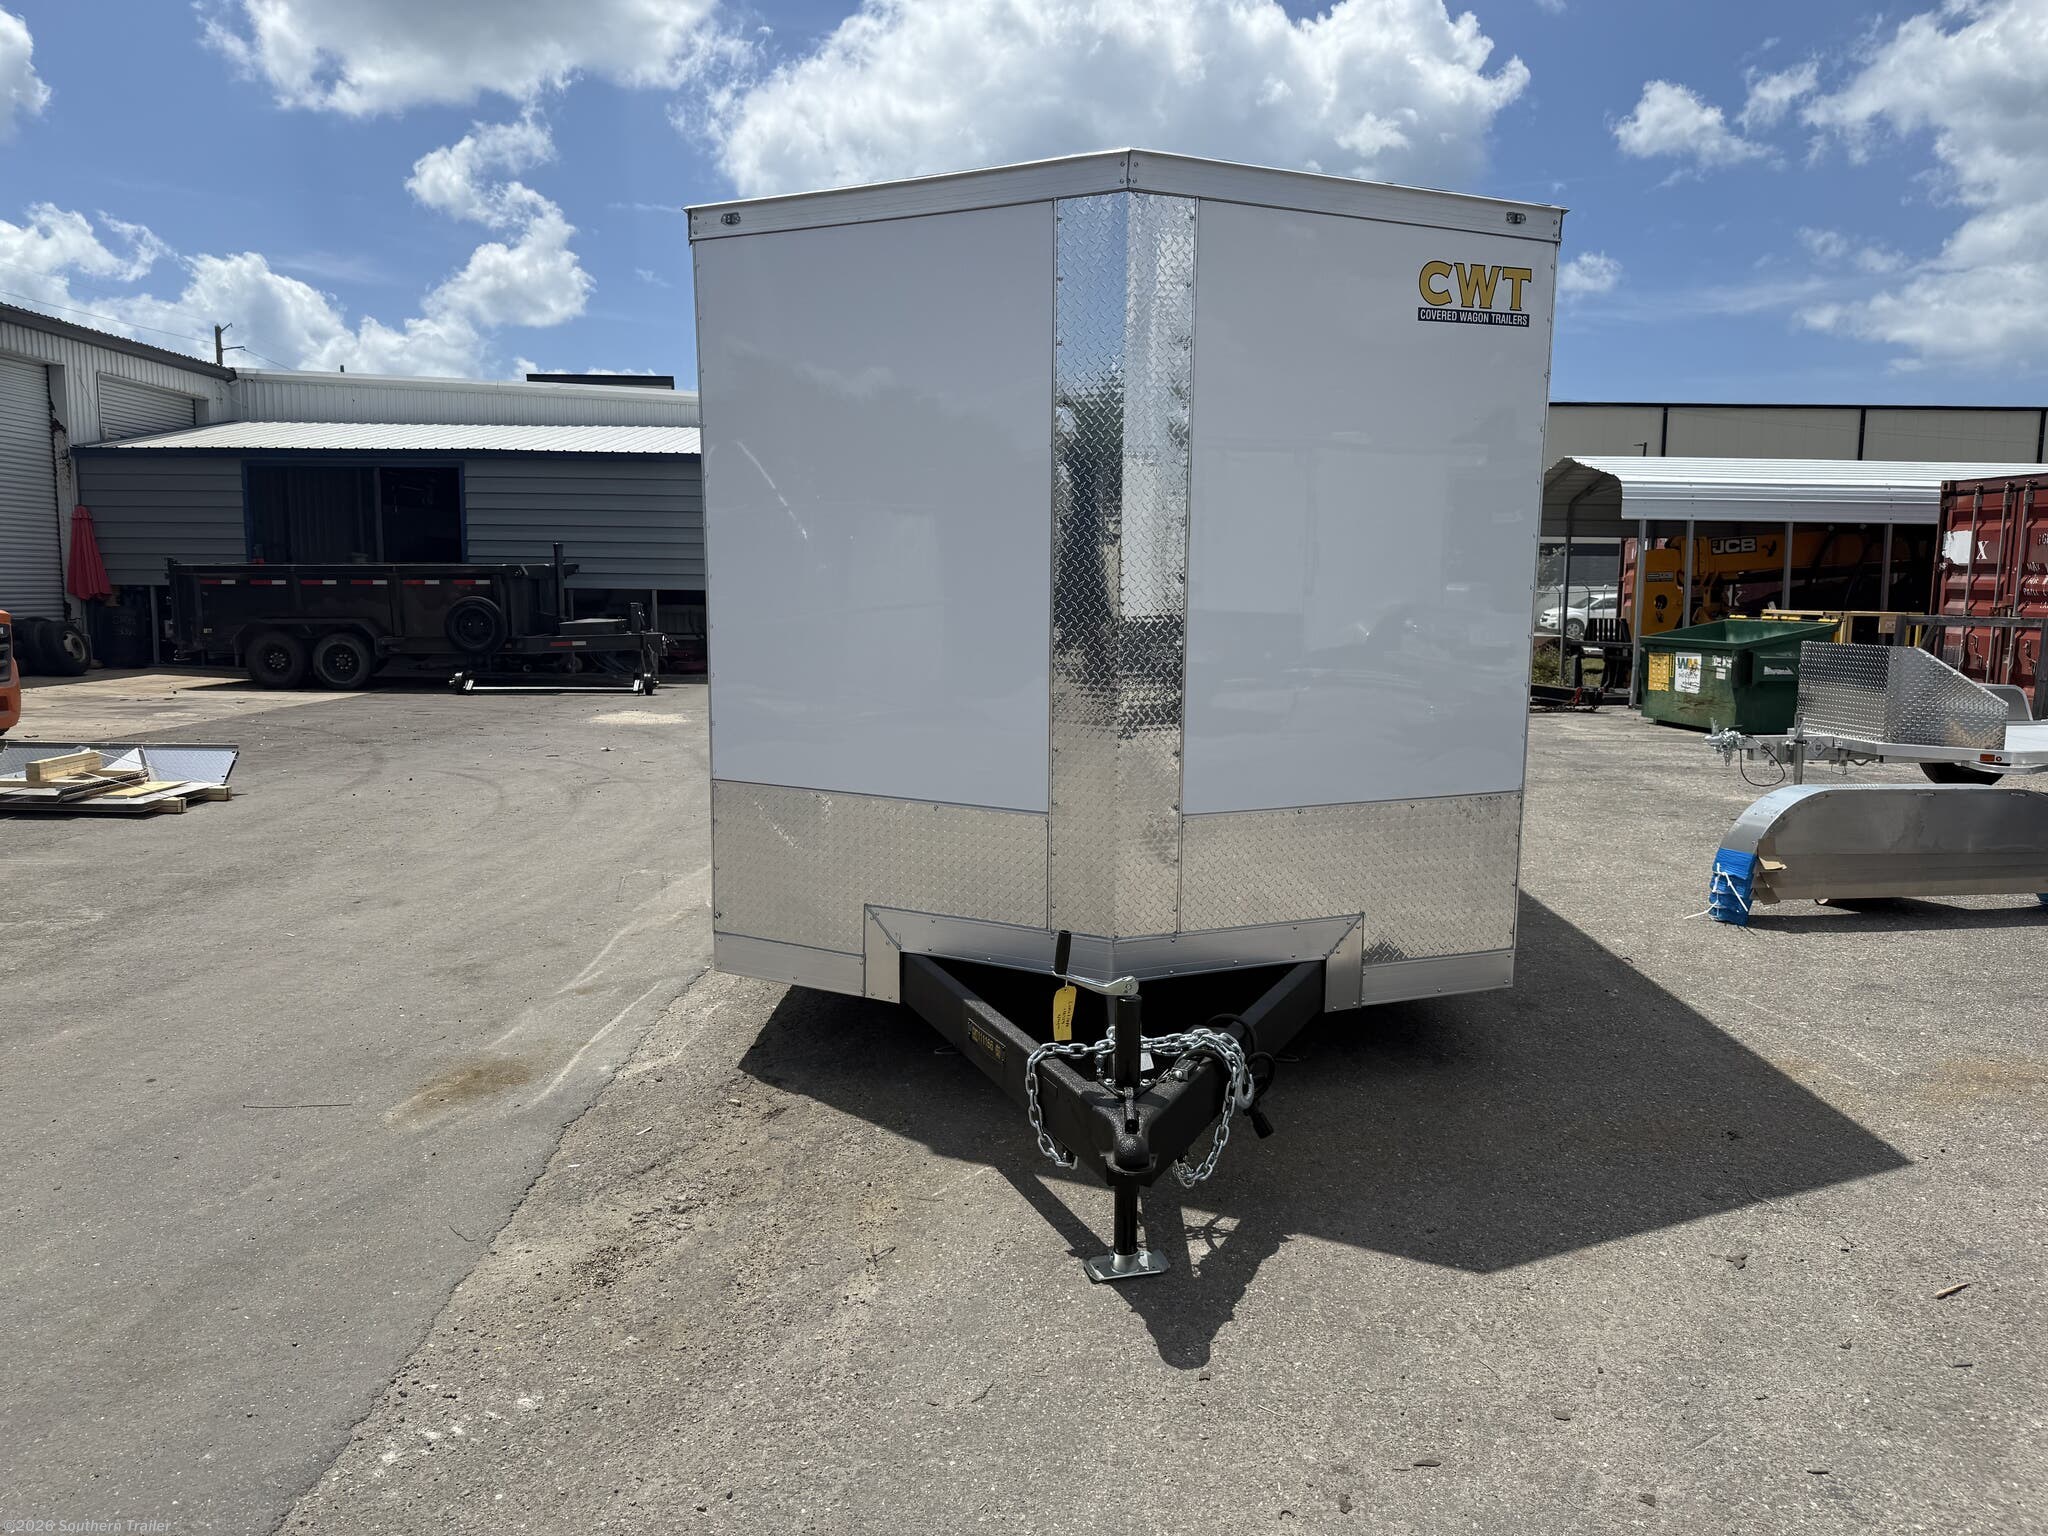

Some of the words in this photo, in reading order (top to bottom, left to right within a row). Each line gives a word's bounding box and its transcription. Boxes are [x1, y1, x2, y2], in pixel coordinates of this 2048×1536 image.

[1419, 260, 1532, 311] CWT
[1420, 308, 1457, 321] COVERED
[1460, 311, 1489, 323] WAGON
[1491, 313, 1528, 326] TRAILERS
[1712, 538, 1756, 554] JCB
